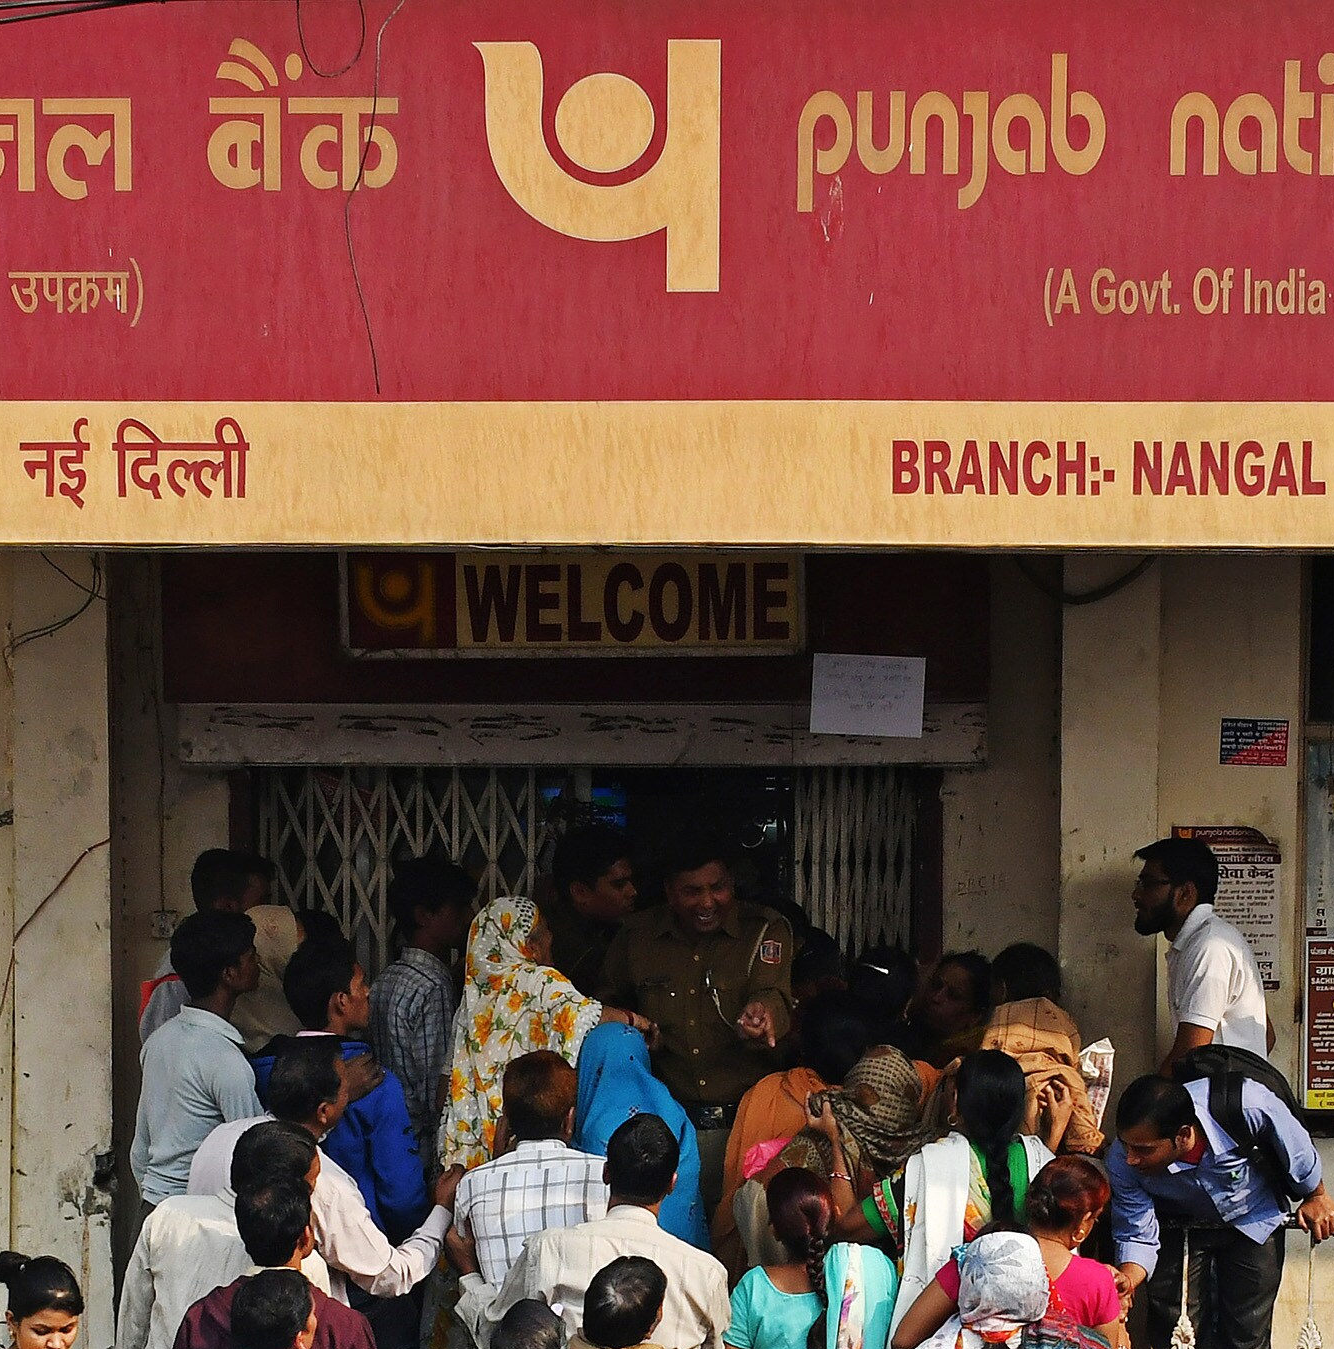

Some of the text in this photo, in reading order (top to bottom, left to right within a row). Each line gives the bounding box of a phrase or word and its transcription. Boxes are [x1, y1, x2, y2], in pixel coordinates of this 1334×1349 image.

[208, 38, 400, 191] बैंक
[797, 54, 1107, 212] punjab
[9, 258, 144, 328] उपक्रम)
[1043, 266, 1079, 328] (A
[1089, 269, 1181, 315] Govt.
[1195, 269, 1233, 315] Of
[1243, 269, 1327, 315] India
[20, 418, 91, 509] नई
[113, 416, 250, 501] दिल्ली
[891, 440, 1116, 498] BRANCH:-
[1131, 440, 1327, 498] NANGAL
[463, 562, 790, 642] WELCOME
[1248, 865, 1275, 879] केन्द्र
